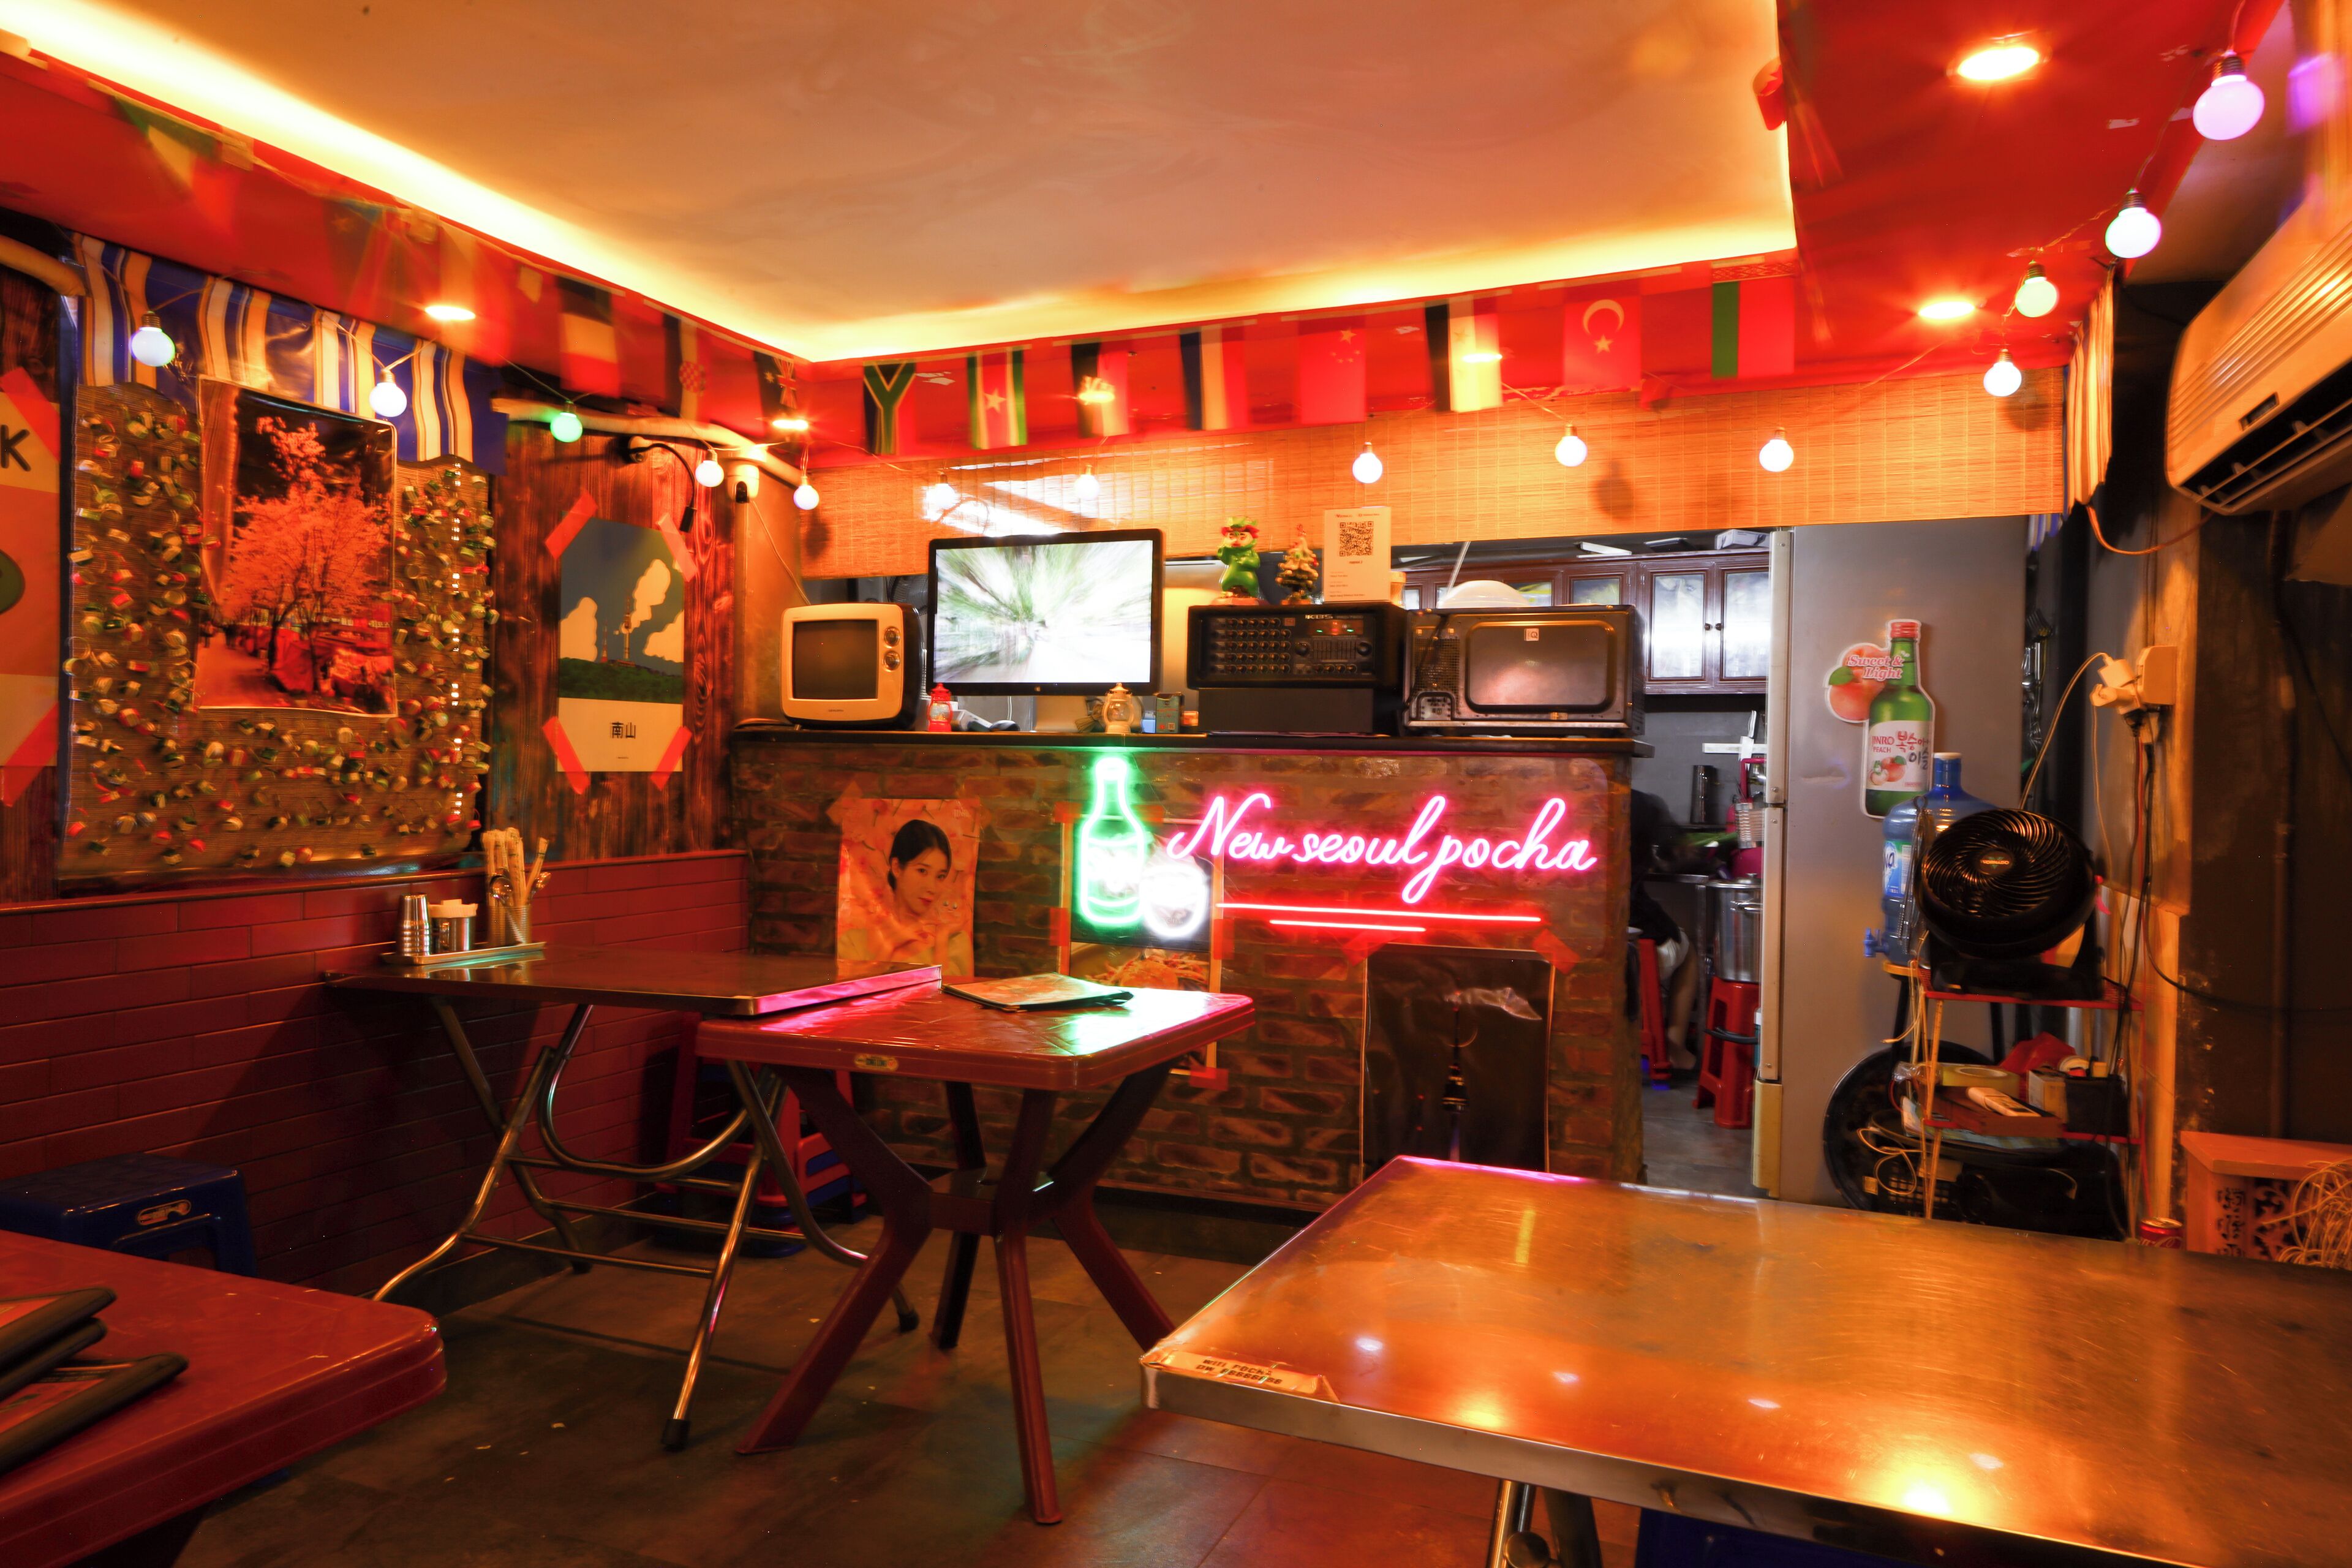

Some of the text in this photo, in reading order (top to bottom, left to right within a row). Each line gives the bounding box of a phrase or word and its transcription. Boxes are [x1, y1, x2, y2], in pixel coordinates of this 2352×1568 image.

[1848, 655, 1904, 666] Sweet &
[1863, 666, 1902, 681] Light
[611, 722, 636, 739] 南山
[1872, 736, 1894, 745] JINRO
[1166, 793, 1598, 904] New seoul pocha
